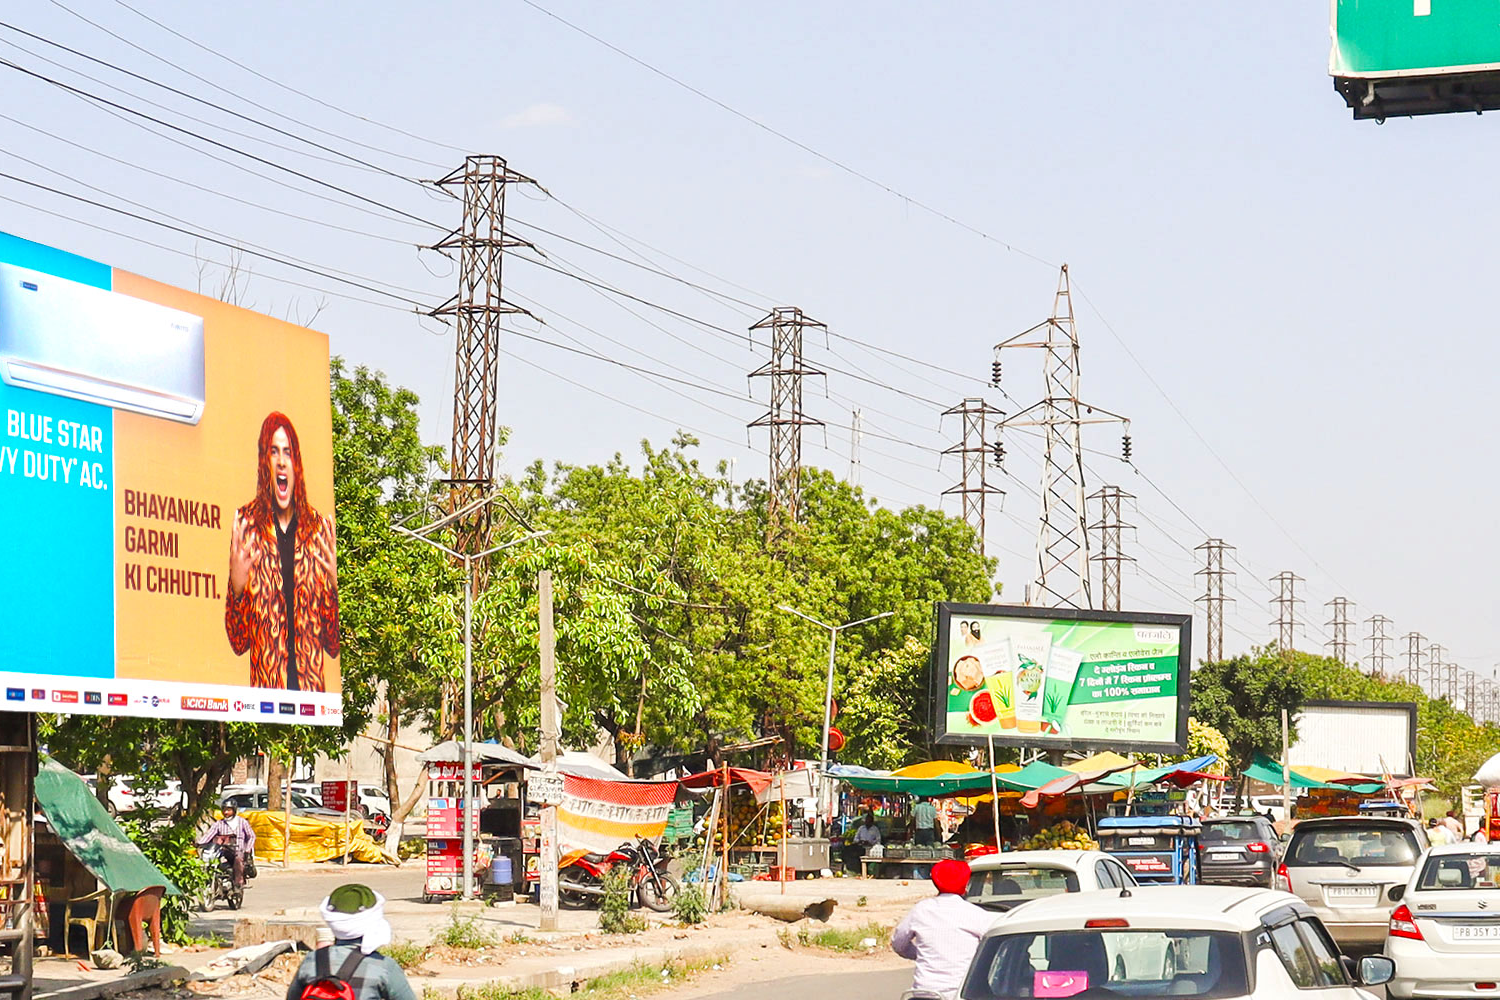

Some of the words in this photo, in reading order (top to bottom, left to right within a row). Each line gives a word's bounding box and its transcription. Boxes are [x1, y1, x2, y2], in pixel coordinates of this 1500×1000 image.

[7, 408, 53, 444] BLUE
[57, 419, 102, 453] STAR
[80, 460, 108, 490] AC.
[124, 489, 221, 530] BHAYANKAR
[125, 526, 178, 558] GARMI
[125, 562, 141, 591] KI
[146, 565, 220, 600] CHHUTTI.
[186, 698, 206, 709] ICICI
[207, 699, 228, 711] Bank
[1104, 686, 1129, 697] 100%
[1459, 927, 1471, 937] PB
[1473, 927, 1490, 937] 35Y
